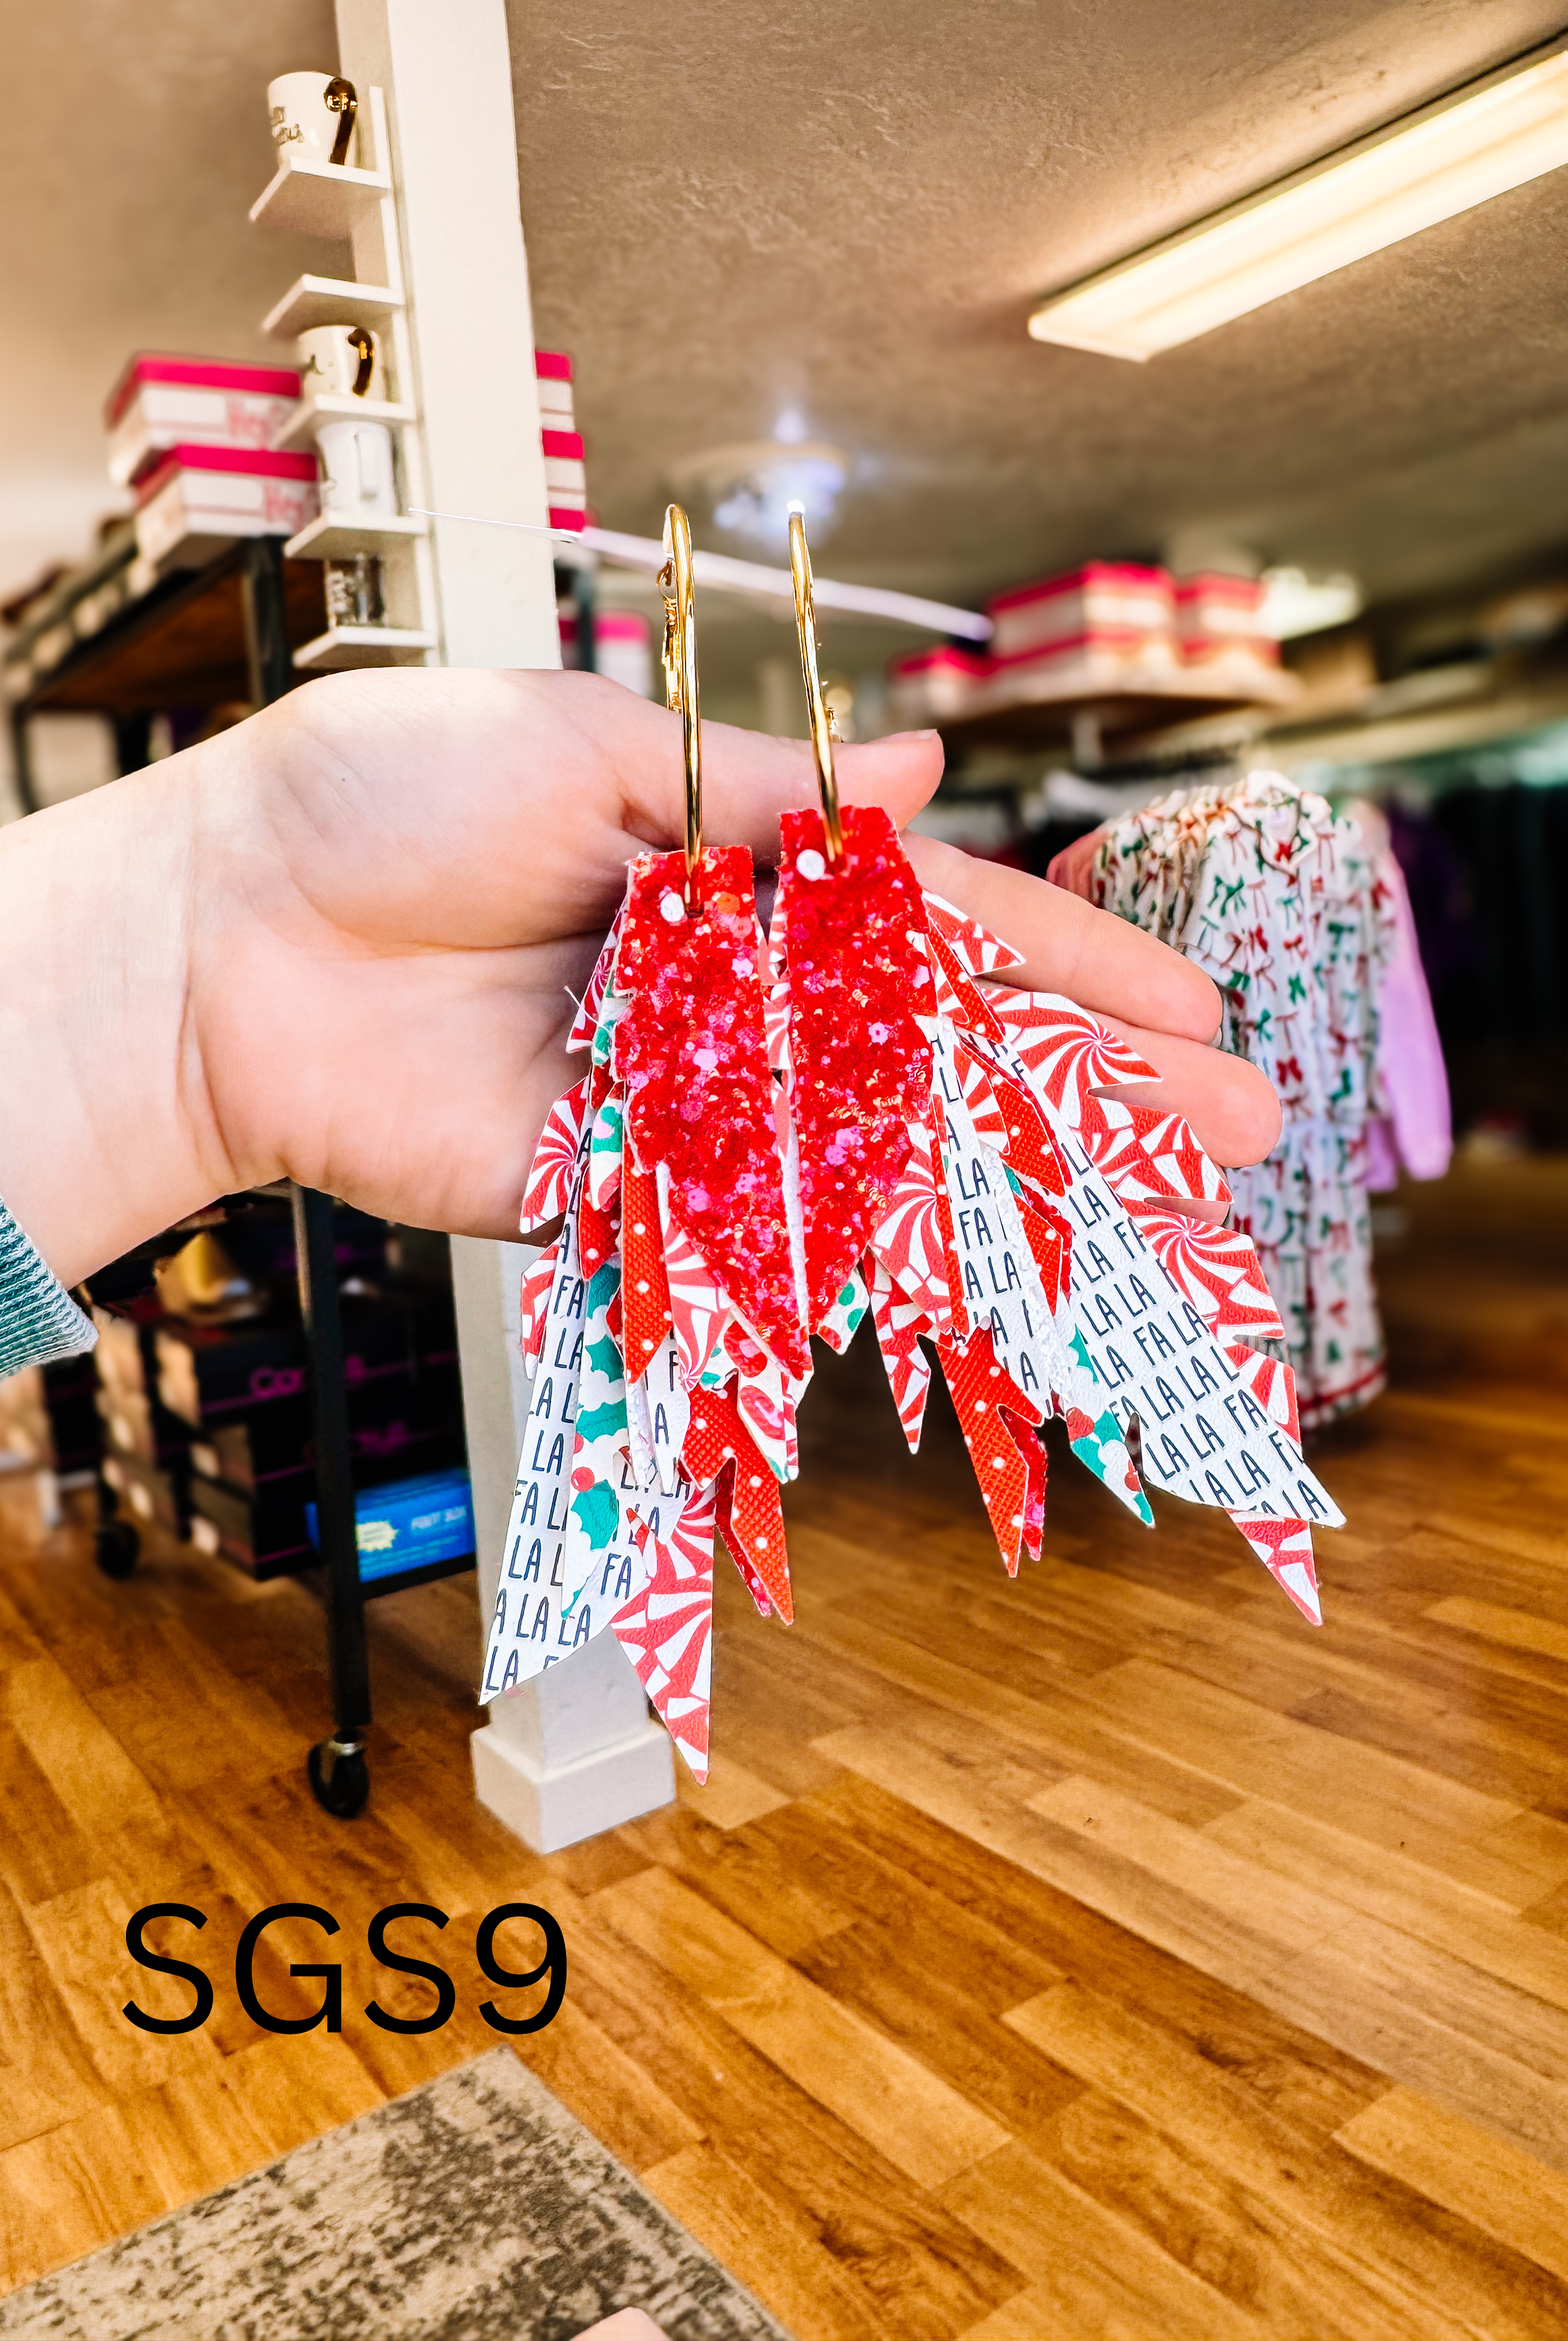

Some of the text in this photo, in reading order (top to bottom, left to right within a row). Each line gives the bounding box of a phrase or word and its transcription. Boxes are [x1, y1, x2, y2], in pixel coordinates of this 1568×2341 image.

[939, 1067, 963, 1103] L
[576, 1128, 592, 1164] A
[946, 1115, 961, 1154] A
[955, 1157, 991, 1200] LA
[958, 1206, 993, 1251] FA
[1068, 1184, 1112, 1229] LA
[964, 1251, 1022, 1301] A LA
[1072, 1240, 1115, 1283] LA
[553, 1275, 584, 1319] FA
[1080, 1294, 1123, 1337] LA
[1114, 1273, 1157, 1317] LA
[554, 1327, 584, 1372] LA
[1091, 1301, 1210, 1390] LA FA LA
[561, 1382, 574, 1423] L
[1108, 1345, 1239, 1437] FA LA LA L
[655, 1403, 669, 1444] A
[1144, 1389, 1267, 1481] LA LA FA
[532, 1429, 564, 1475] LA
[1224, 1449, 1271, 1497] LA
[547, 1487, 568, 1532] L
[509, 1535, 542, 1583] LA
[550, 1543, 563, 1586] L
[600, 1553, 632, 1600] FA
[496, 1588, 591, 1648] A LA LA
[485, 1645, 518, 1691] LA
